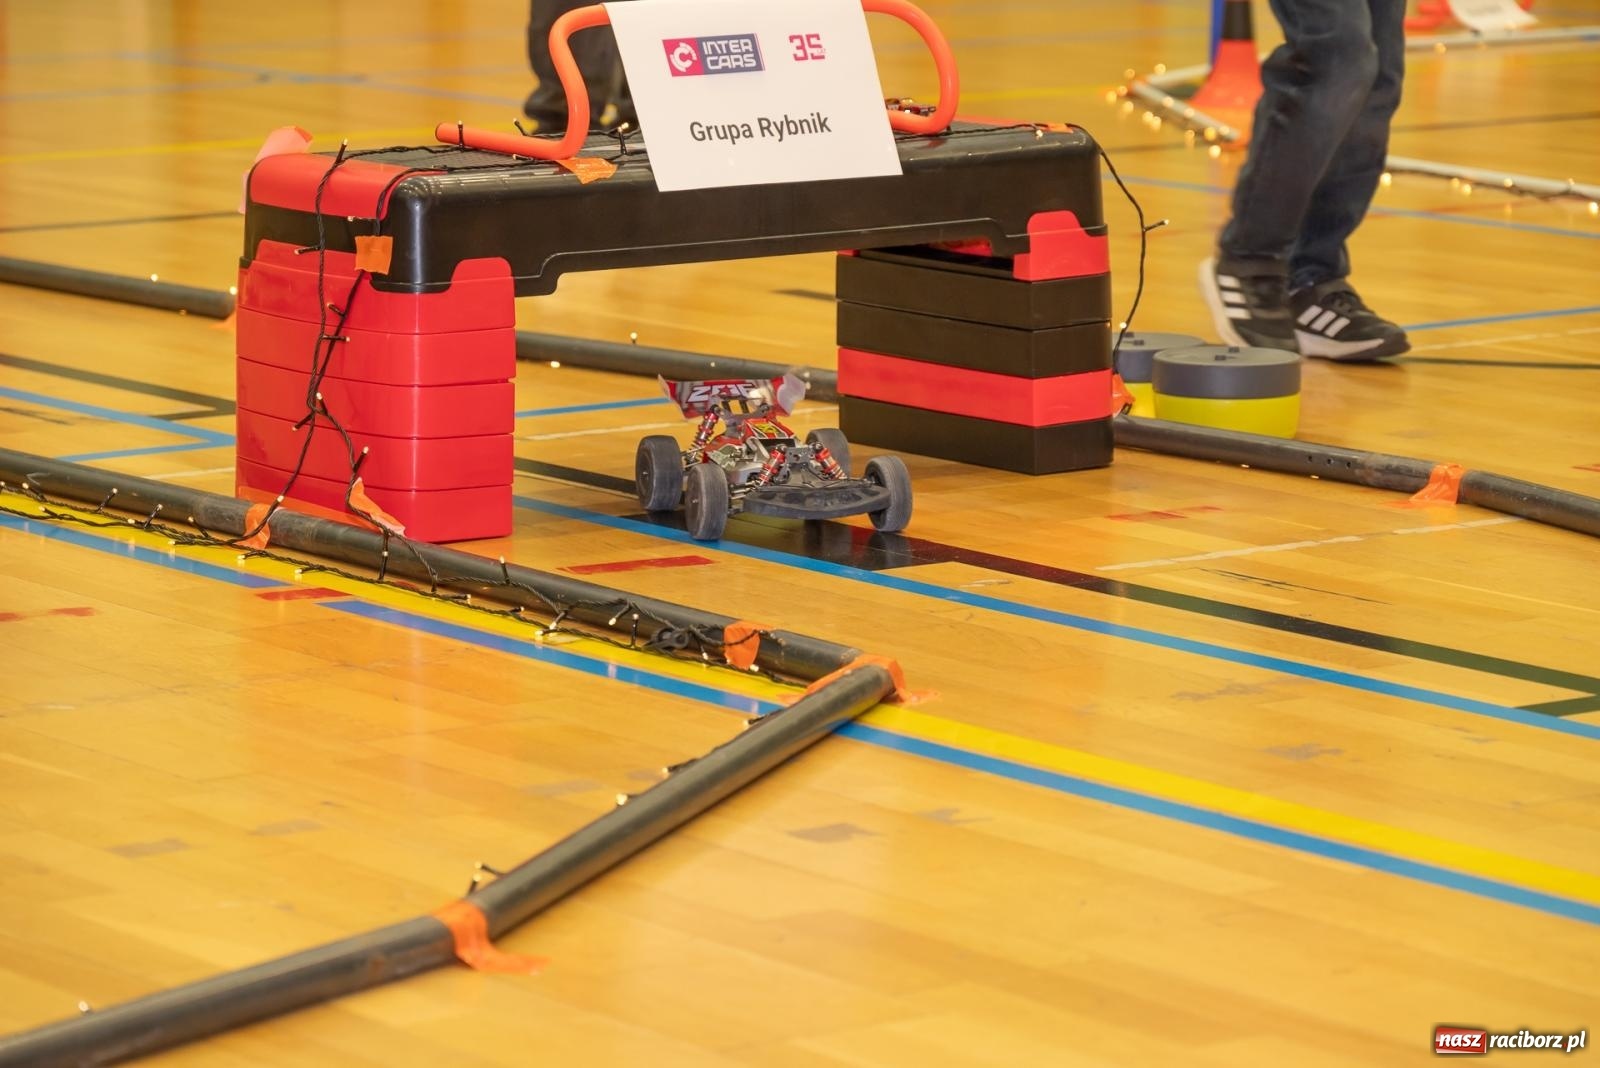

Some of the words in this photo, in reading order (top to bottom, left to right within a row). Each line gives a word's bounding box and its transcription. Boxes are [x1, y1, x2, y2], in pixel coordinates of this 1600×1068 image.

[702, 39, 753, 55] INTER
[789, 33, 825, 61] 35
[706, 53, 757, 70] CARS
[689, 121, 754, 145] Grupa
[757, 111, 832, 142] Rybnik
